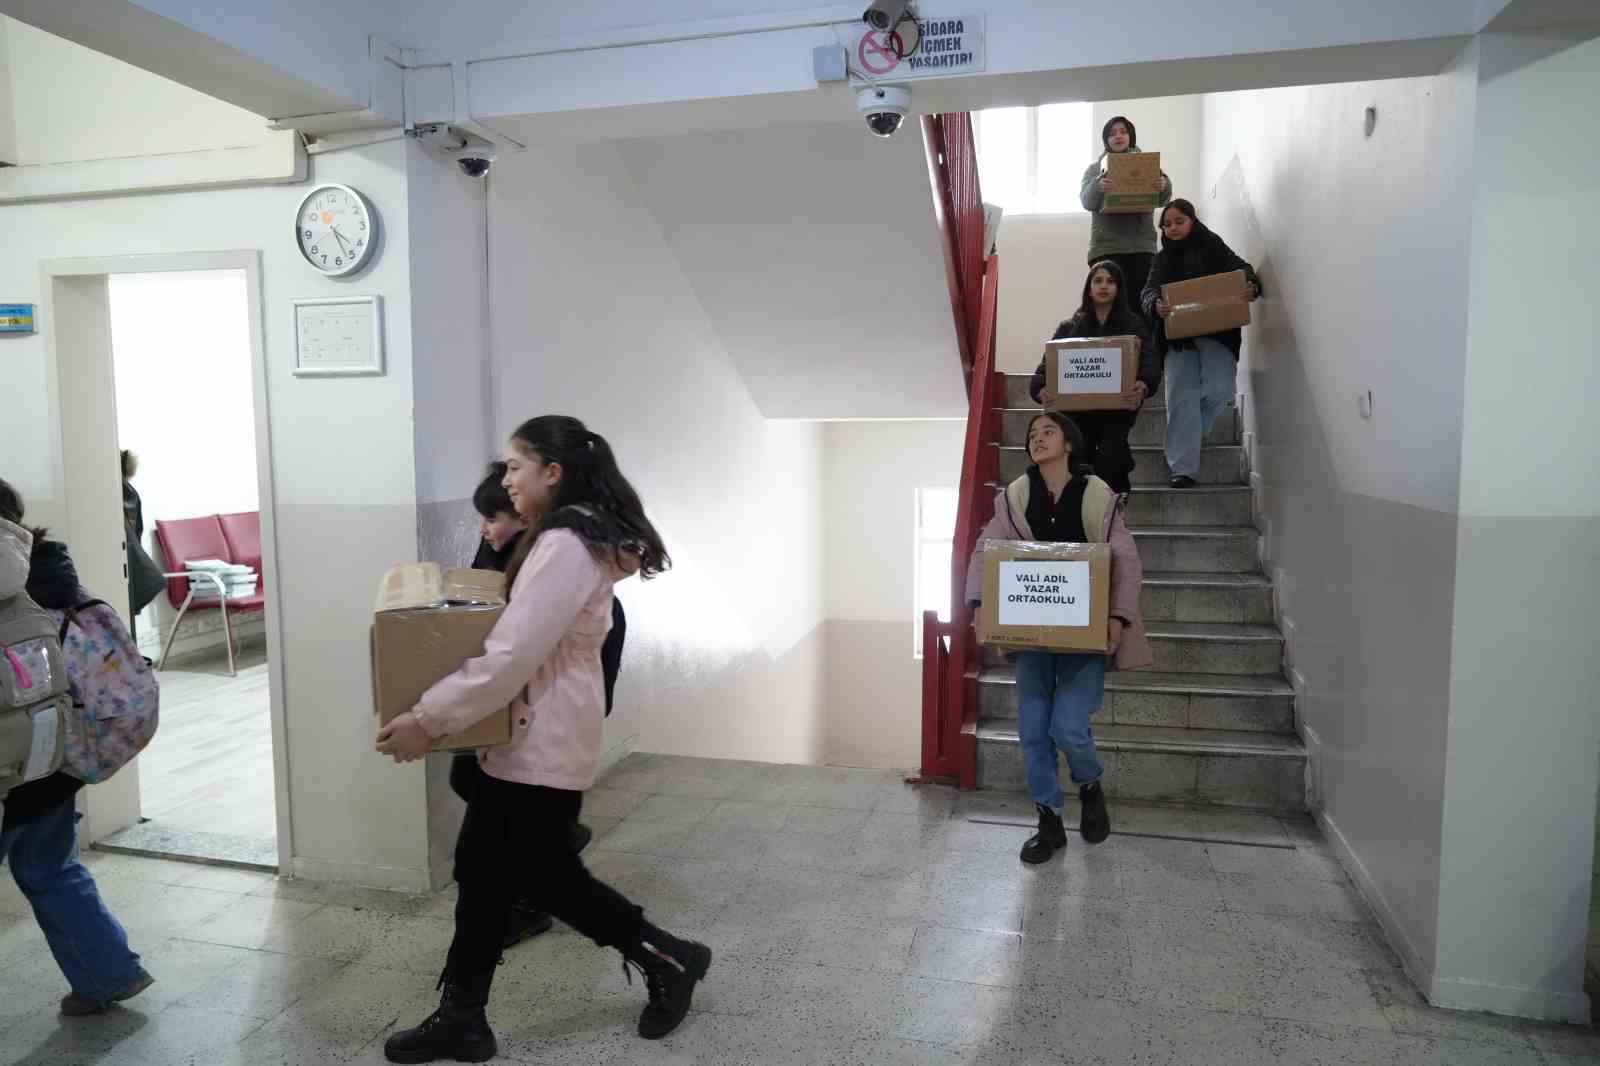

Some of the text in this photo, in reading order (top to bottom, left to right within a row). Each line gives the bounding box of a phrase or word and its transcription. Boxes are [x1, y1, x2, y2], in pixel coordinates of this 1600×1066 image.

[359, 221, 367, 231] 3
[304, 230, 313, 240] 9
[356, 238, 364, 247] 4
[311, 244, 319, 255] 8
[348, 249, 356, 260] 5
[320, 254, 328, 265] 7
[334, 256, 343, 266] 6
[1023, 584, 1060, 594] YAZAR
[1007, 594, 1076, 605] ORTAOKULU
